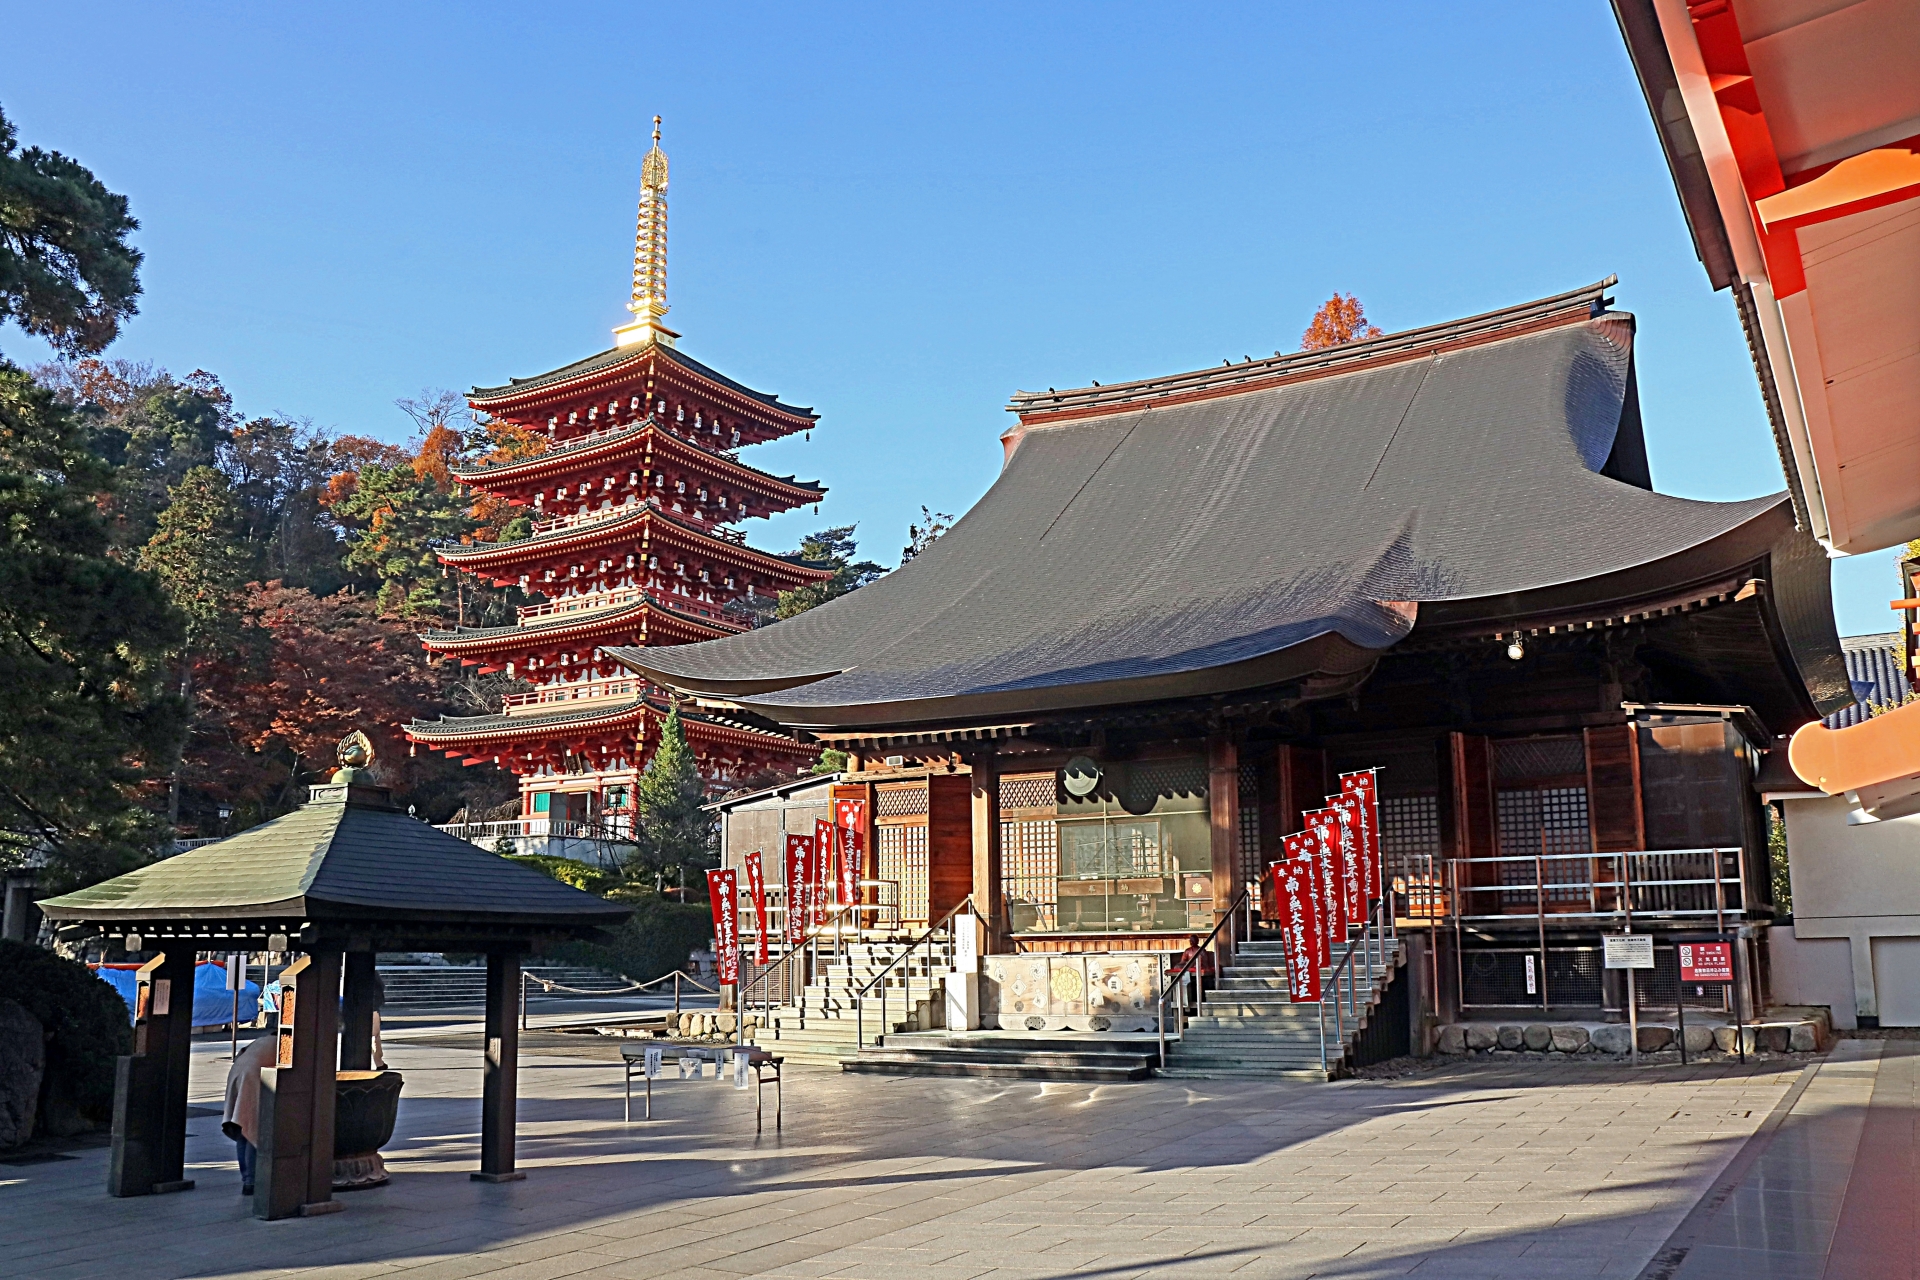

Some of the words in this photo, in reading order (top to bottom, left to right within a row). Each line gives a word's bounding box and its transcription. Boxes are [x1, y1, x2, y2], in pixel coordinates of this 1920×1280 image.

[1346, 777, 1369, 788] 奉納
[1309, 815, 1334, 826] 奉納
[1289, 837, 1314, 851] 奉納
[712, 873, 733, 882] 奉納
[1277, 866, 1304, 878] 奉納
[718, 882, 738, 981] 南無大聖不動明王
[1284, 876, 1312, 998] 南無大聖不動明王
